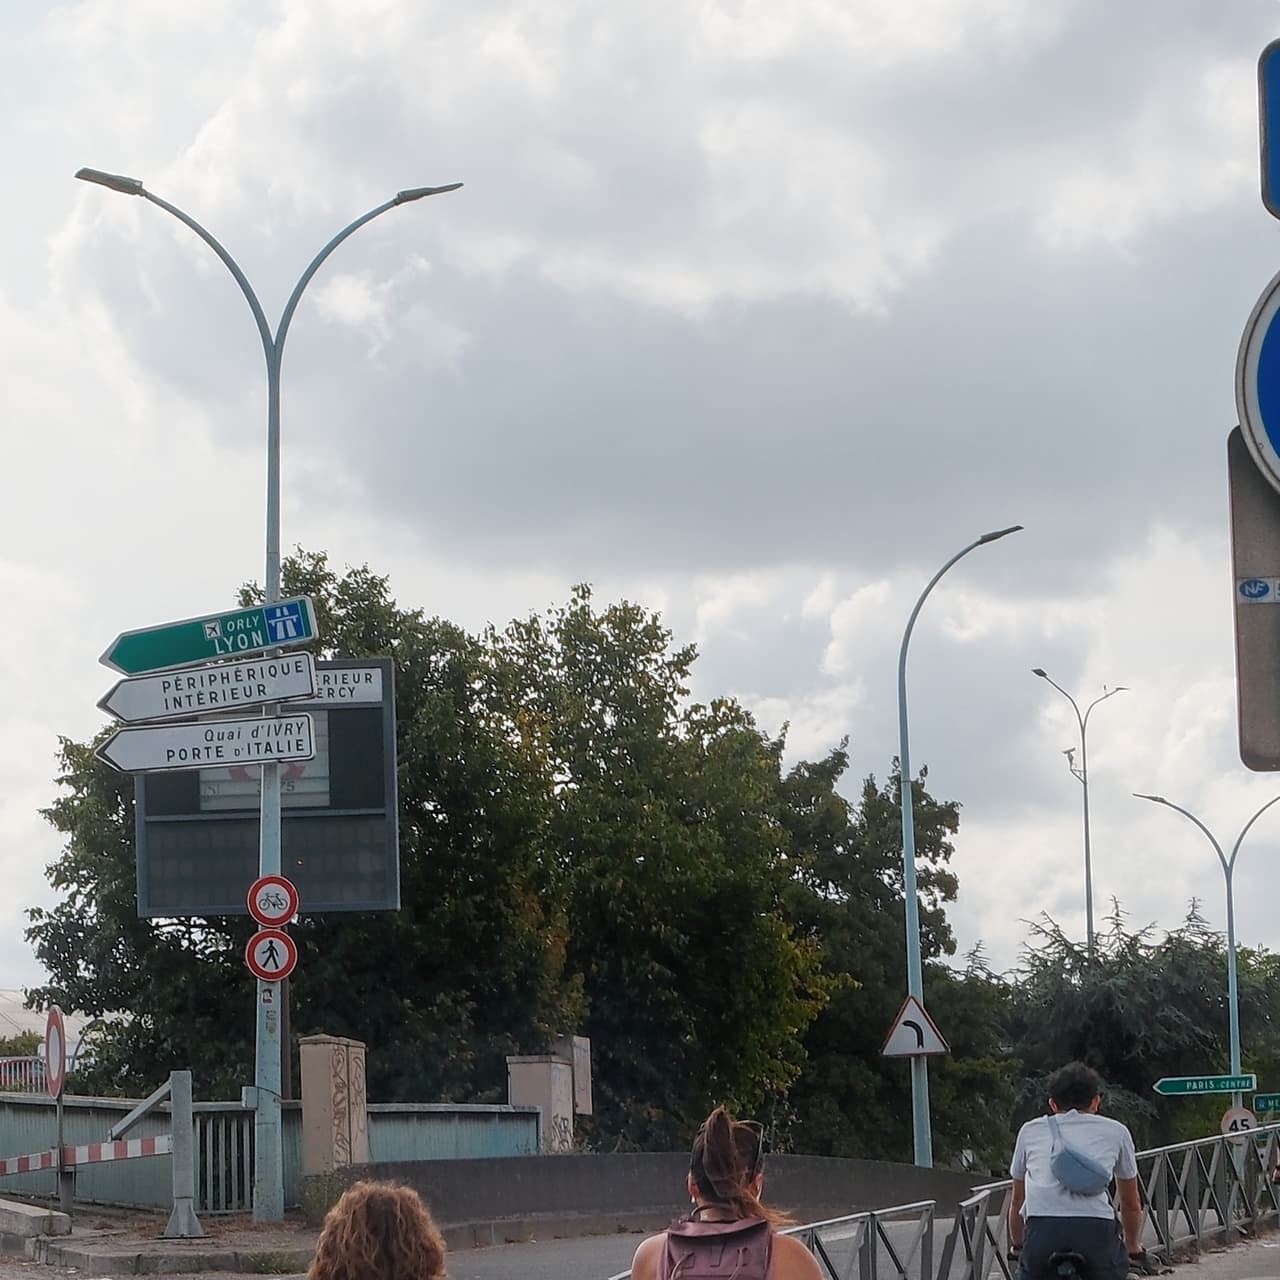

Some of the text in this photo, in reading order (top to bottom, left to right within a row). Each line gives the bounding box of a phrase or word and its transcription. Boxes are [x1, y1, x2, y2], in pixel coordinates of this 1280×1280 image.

[227, 615, 260, 632] ORLY
[214, 630, 264, 655] LYON
[162, 660, 304, 694] PÉRIPHÉRIQUE
[315, 672, 373, 686] RIEUR
[164, 683, 267, 711] INTÉRIEUR
[316, 686, 356, 699] ERCY
[204, 721, 305, 742] Quai d'IVRY
[167, 745, 224, 762] PORTE
[1228, 1118, 1250, 1133] 45
